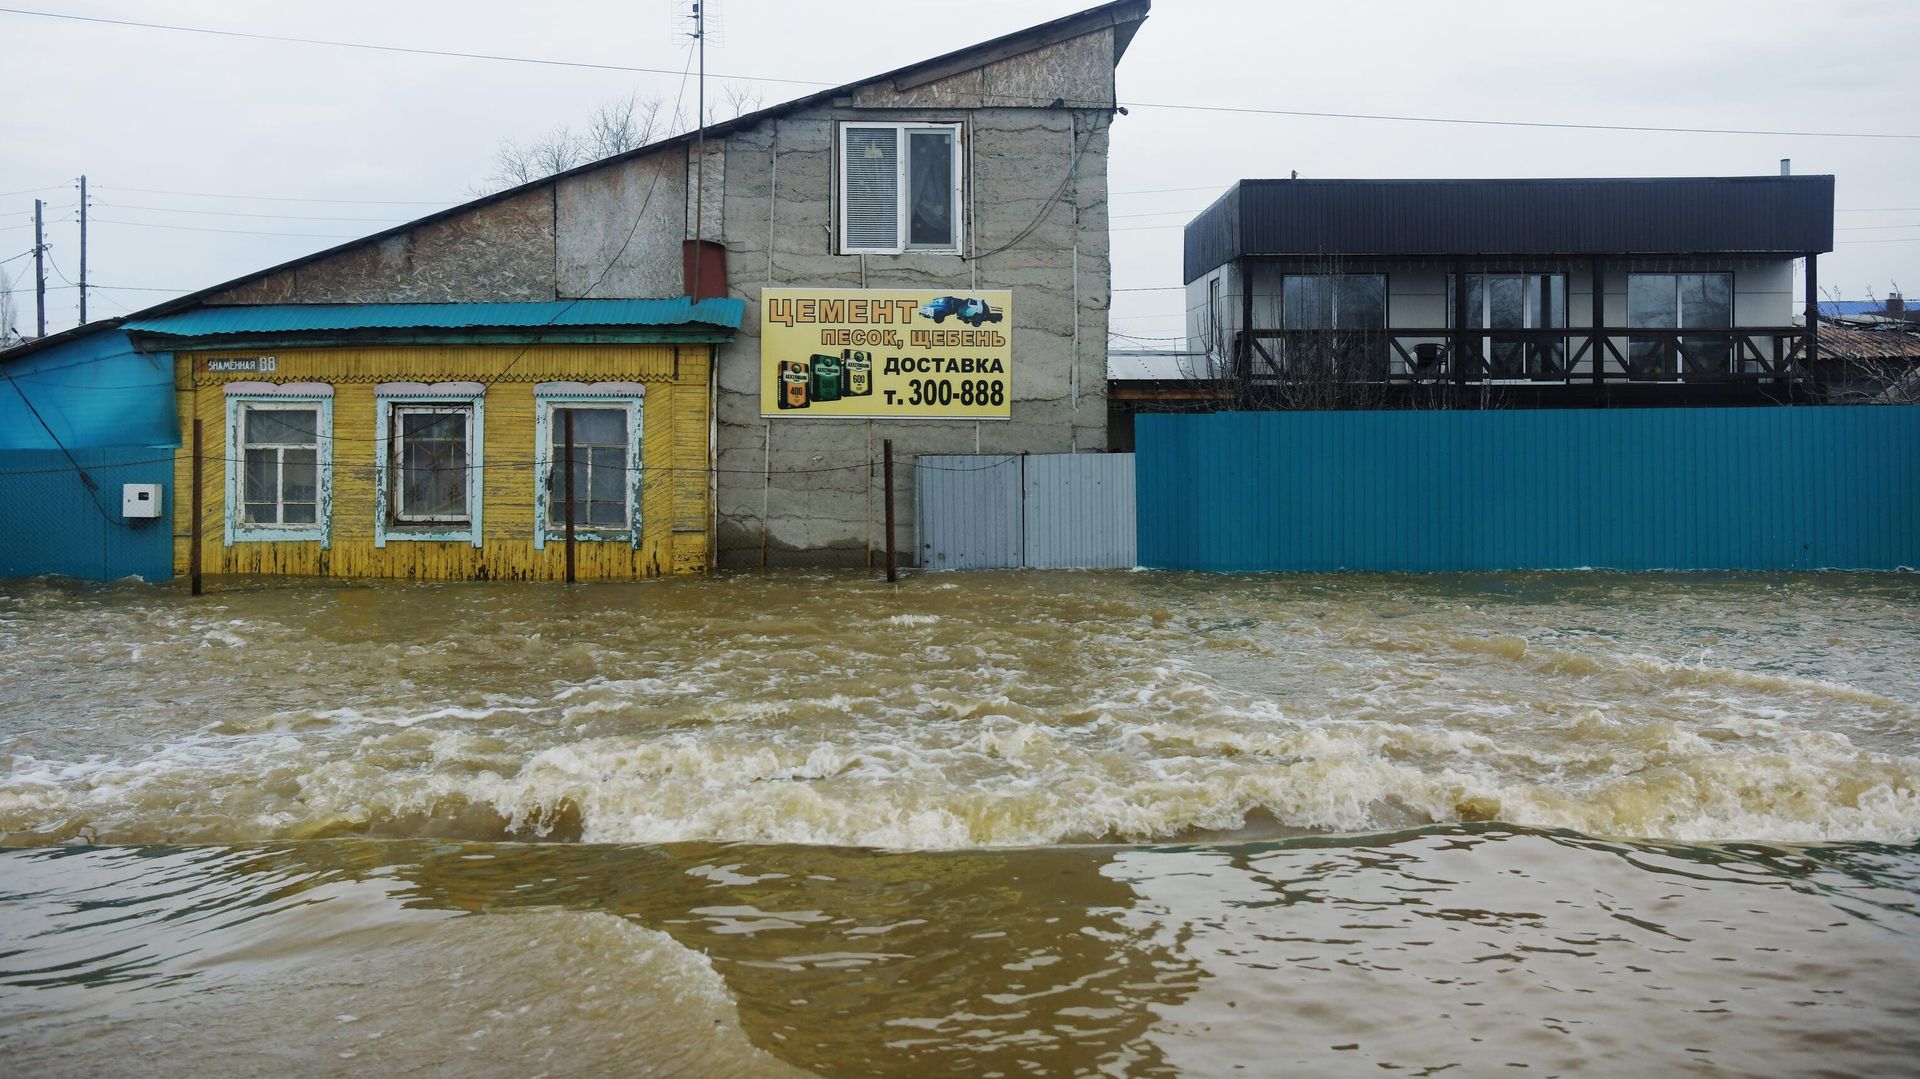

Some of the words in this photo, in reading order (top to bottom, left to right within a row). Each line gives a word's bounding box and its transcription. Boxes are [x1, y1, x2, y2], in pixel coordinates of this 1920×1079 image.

[769, 299, 918, 327] ЦЕМЕНТ
[821, 329, 903, 349] ПЕСОК,
[911, 330, 1006, 349] ЩЕБЕНЬ
[259, 357, 276, 371] 88
[884, 358, 1004, 375] ДОСТАВКА
[908, 379, 1004, 406] 300-888
